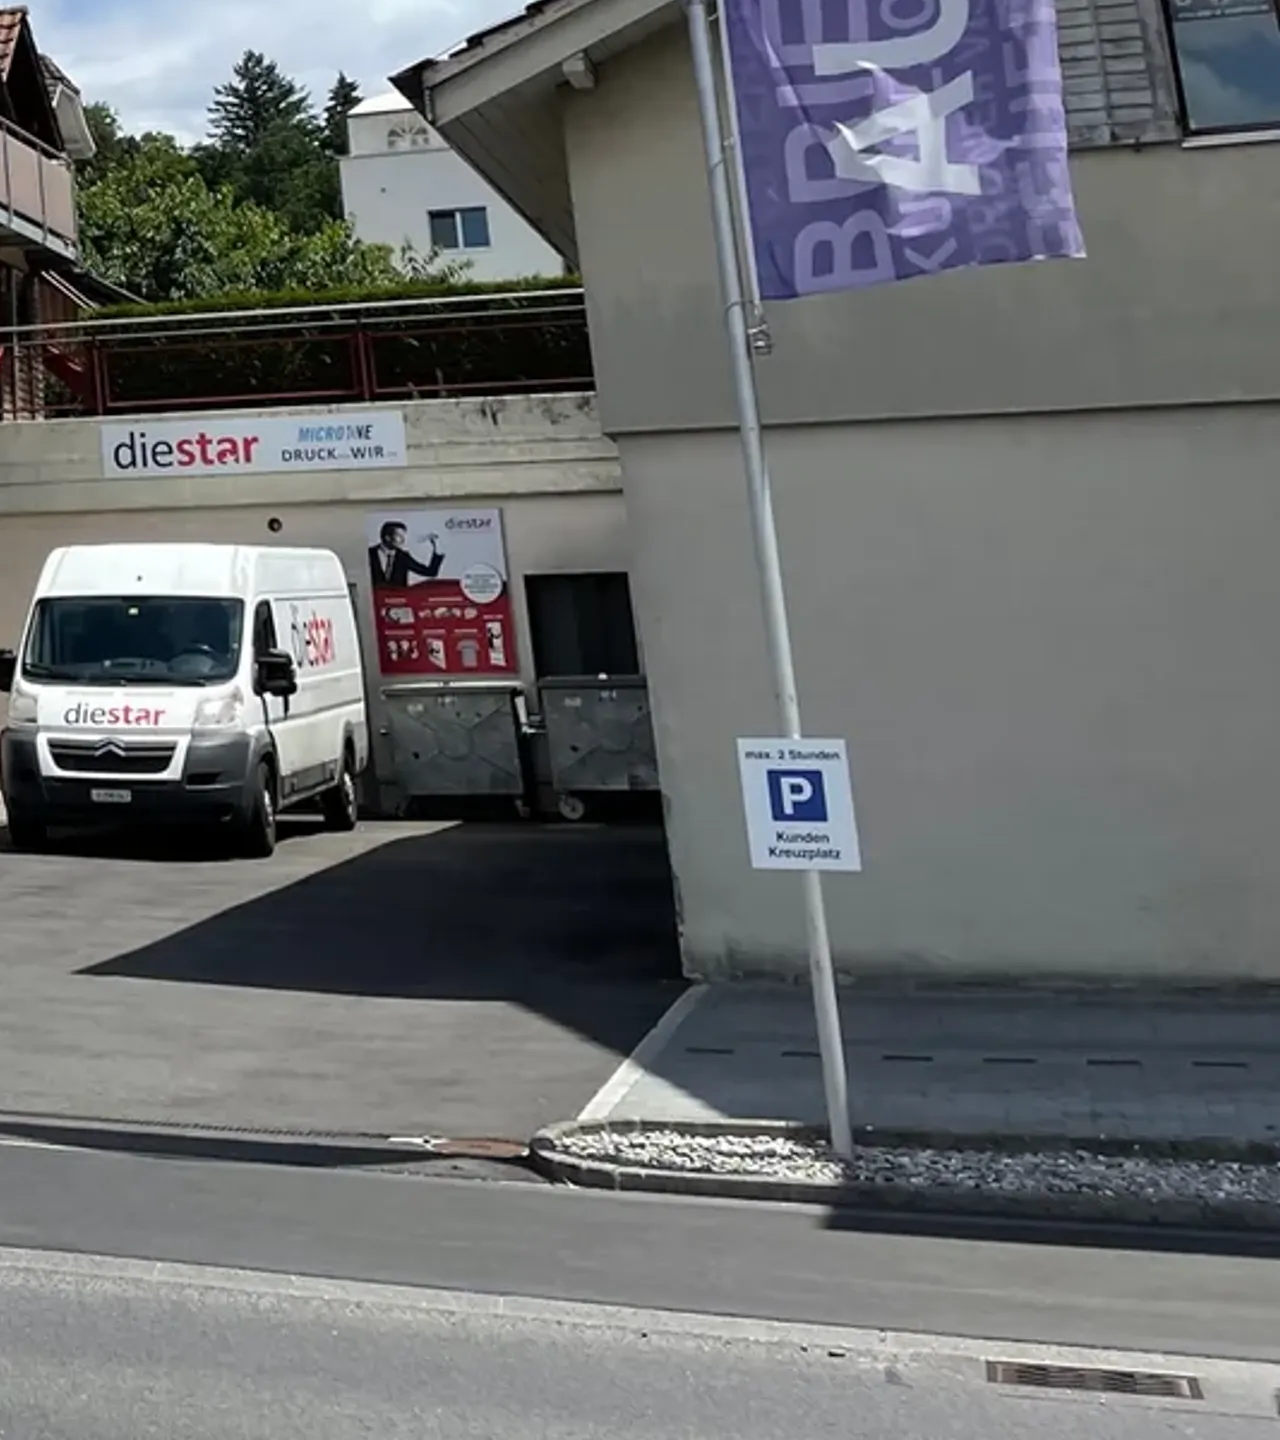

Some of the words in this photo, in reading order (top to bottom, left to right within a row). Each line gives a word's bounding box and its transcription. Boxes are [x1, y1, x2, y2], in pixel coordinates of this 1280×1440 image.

[113, 431, 259, 469] diestar
[281, 447, 338, 462] DRUCK
[63, 703, 166, 726] diestar
[788, 749, 841, 760] Stunden
[780, 777, 813, 815] P
[776, 831, 830, 843] Kunden
[768, 847, 841, 861] Kreuzplatz
